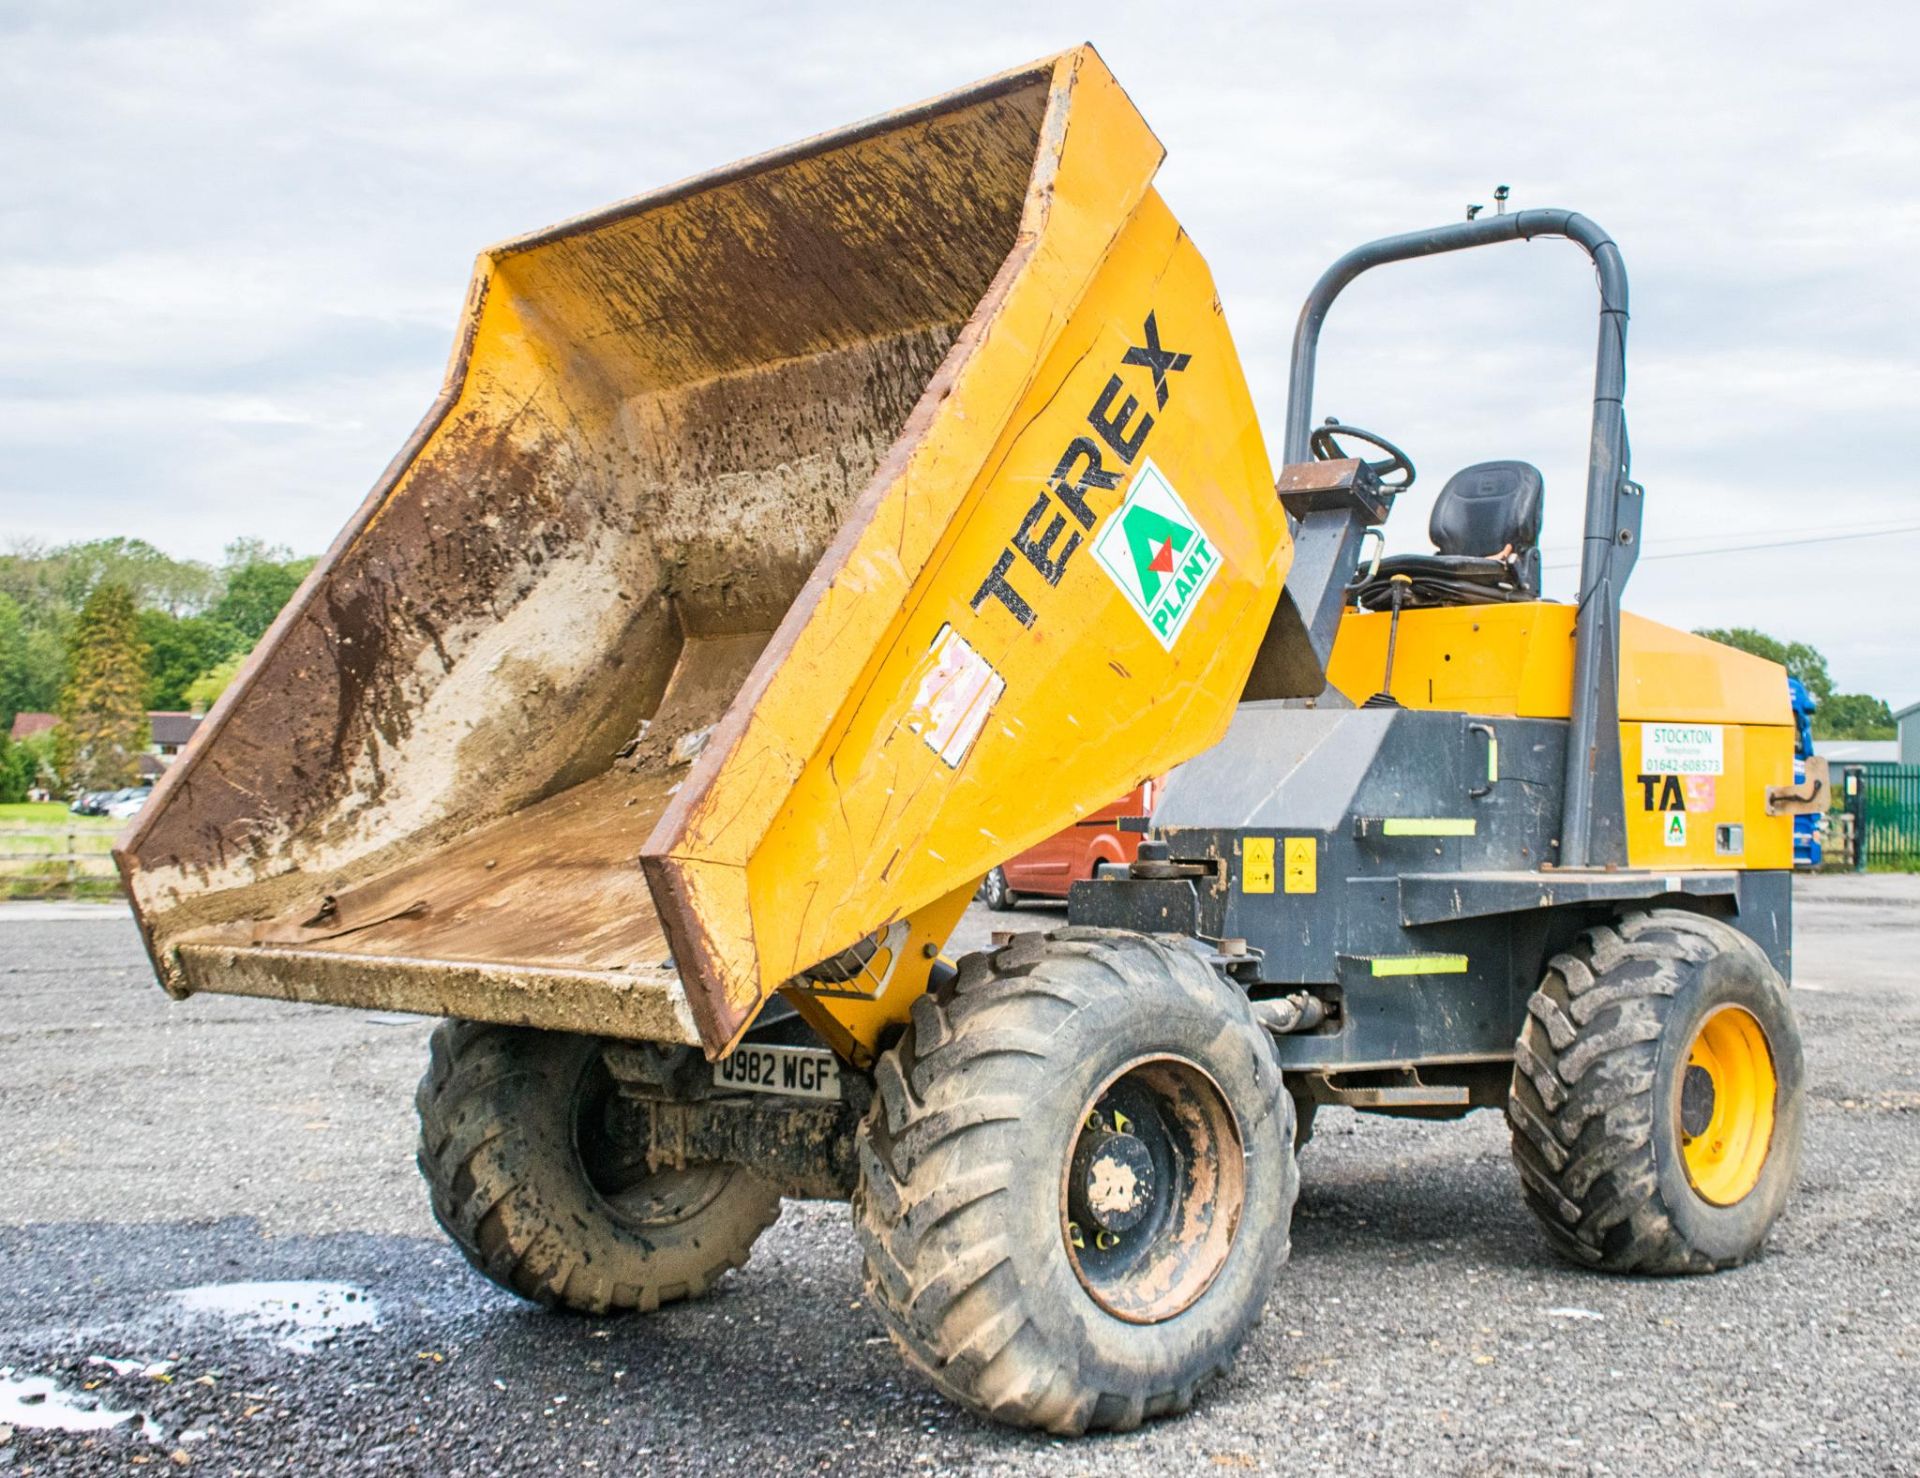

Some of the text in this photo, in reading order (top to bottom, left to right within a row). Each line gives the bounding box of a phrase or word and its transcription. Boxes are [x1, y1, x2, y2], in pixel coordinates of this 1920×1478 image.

[969, 309, 1192, 630] TEREX
[1122, 504, 1194, 607] A
[1152, 538, 1211, 637] PLANT
[1646, 759, 1720, 772] 01642-608573
[1654, 728, 1712, 743] STOCKTON
[783, 1055, 831, 1090] WGF
